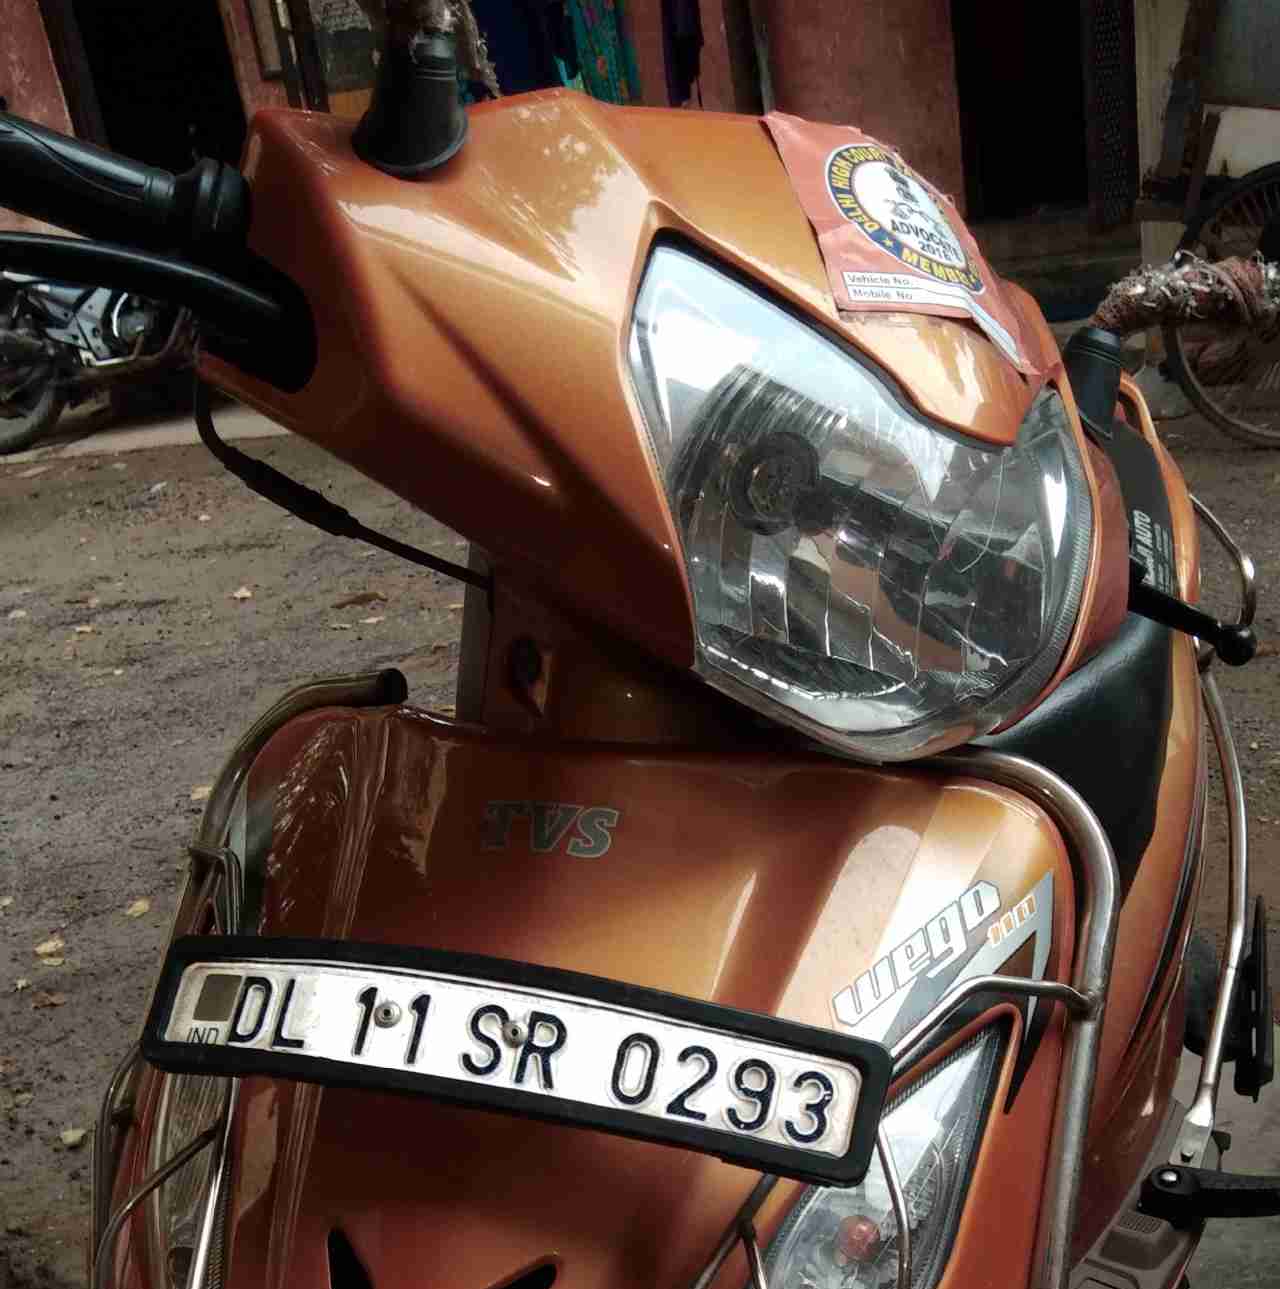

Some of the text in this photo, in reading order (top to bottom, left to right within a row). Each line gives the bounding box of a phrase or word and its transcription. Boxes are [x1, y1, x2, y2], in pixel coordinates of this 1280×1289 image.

[847, 273, 890, 285] Vehicle
[852, 287, 892, 299] Mobile
[1132, 509, 1153, 548] AUTO
[480, 799, 620, 859] TVS
[986, 894, 1037, 950] 110
[832, 879, 1001, 1028] wego
[187, 1027, 220, 1046] IND
[227, 976, 834, 1144] DL 11 SR 0293
